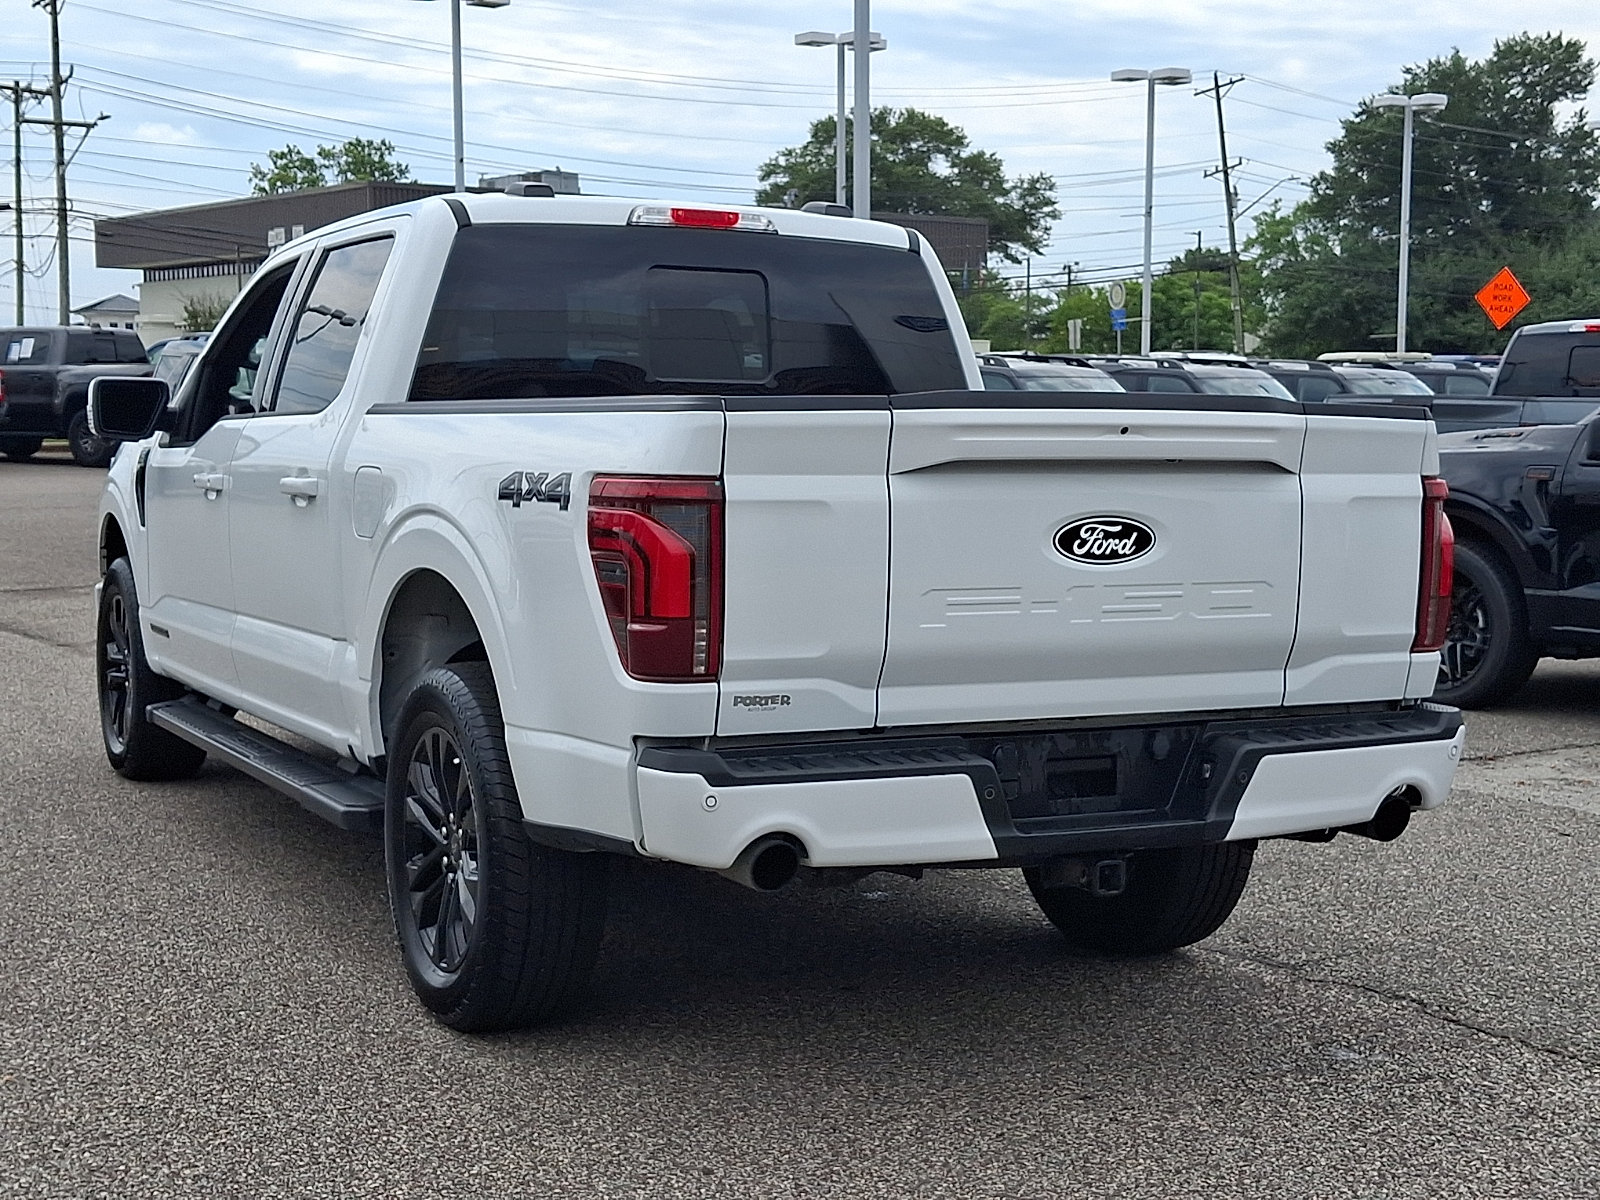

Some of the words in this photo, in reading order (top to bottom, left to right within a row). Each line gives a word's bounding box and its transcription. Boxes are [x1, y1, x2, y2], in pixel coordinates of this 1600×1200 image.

[1493, 283, 1514, 291] ROAD
[1493, 294, 1513, 302] WORK
[1489, 305, 1514, 313] AHEAD
[1073, 523, 1138, 556] Ford
[733, 694, 791, 707] PORTER
